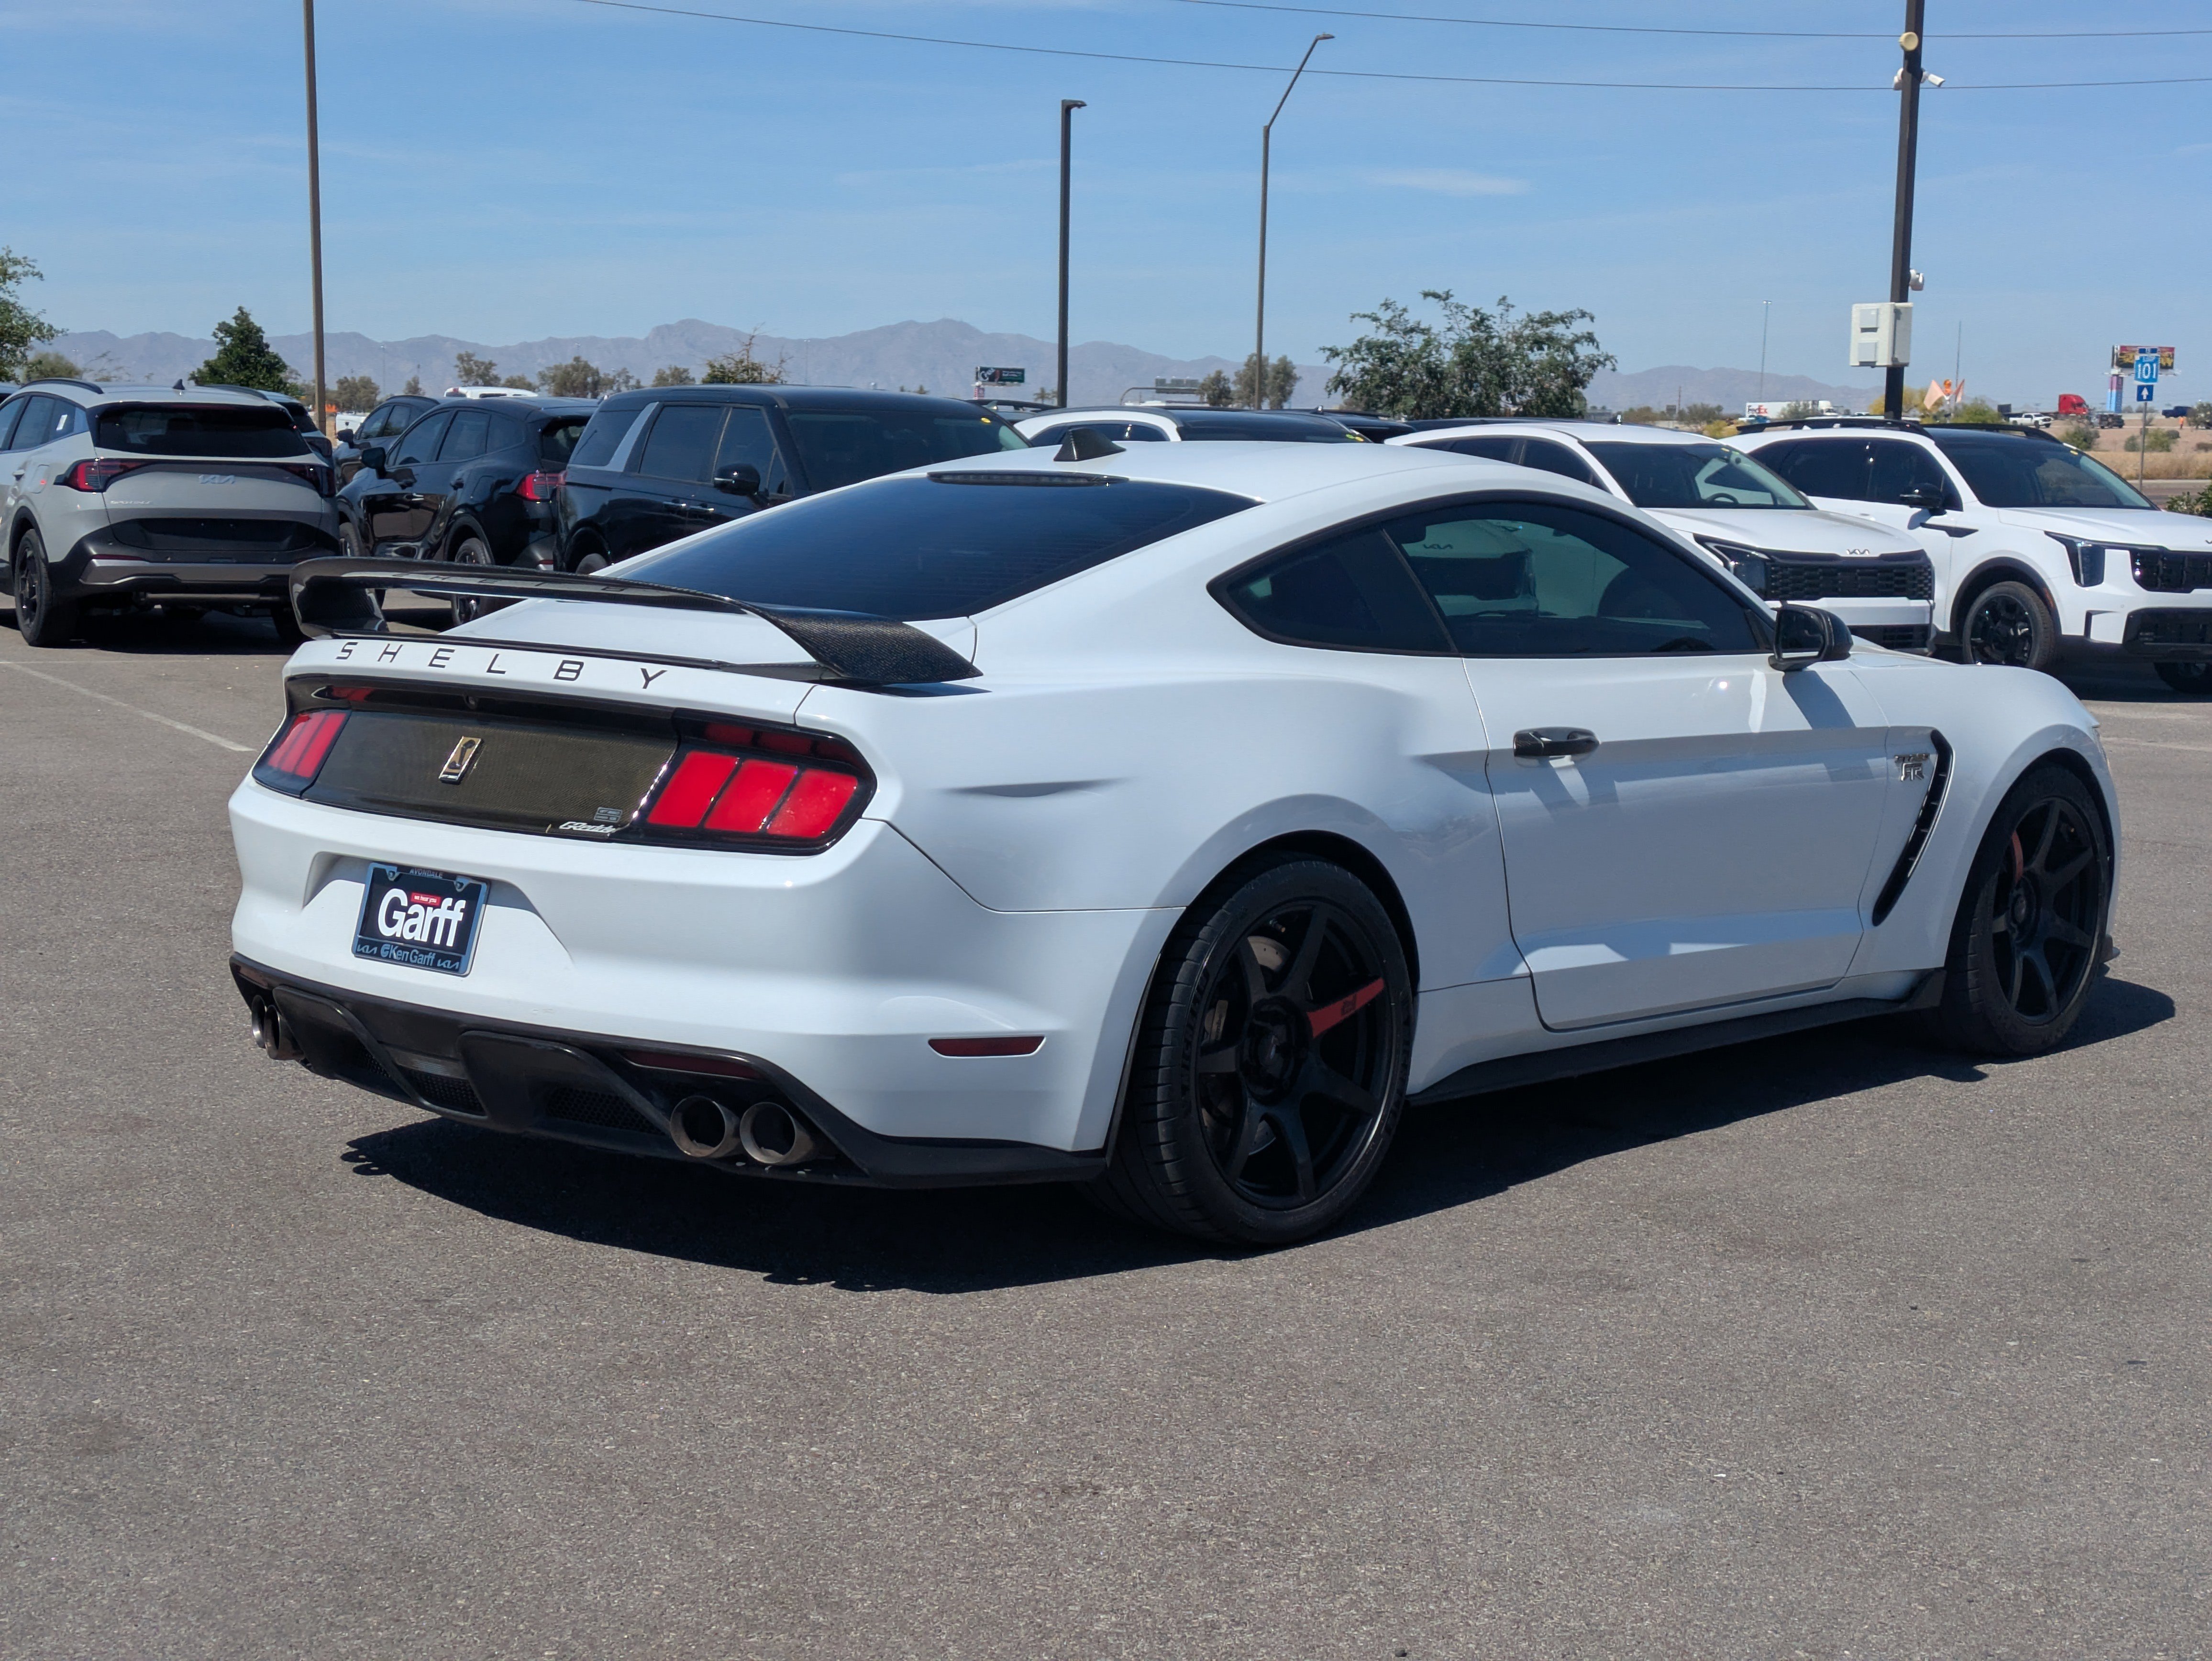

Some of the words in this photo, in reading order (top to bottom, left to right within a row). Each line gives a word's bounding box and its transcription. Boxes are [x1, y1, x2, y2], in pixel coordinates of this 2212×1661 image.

[2137, 363, 2156, 379] 101
[336, 642, 667, 689] SHELBY
[378, 888, 466, 947] Garff
[409, 949, 436, 966] Garff
